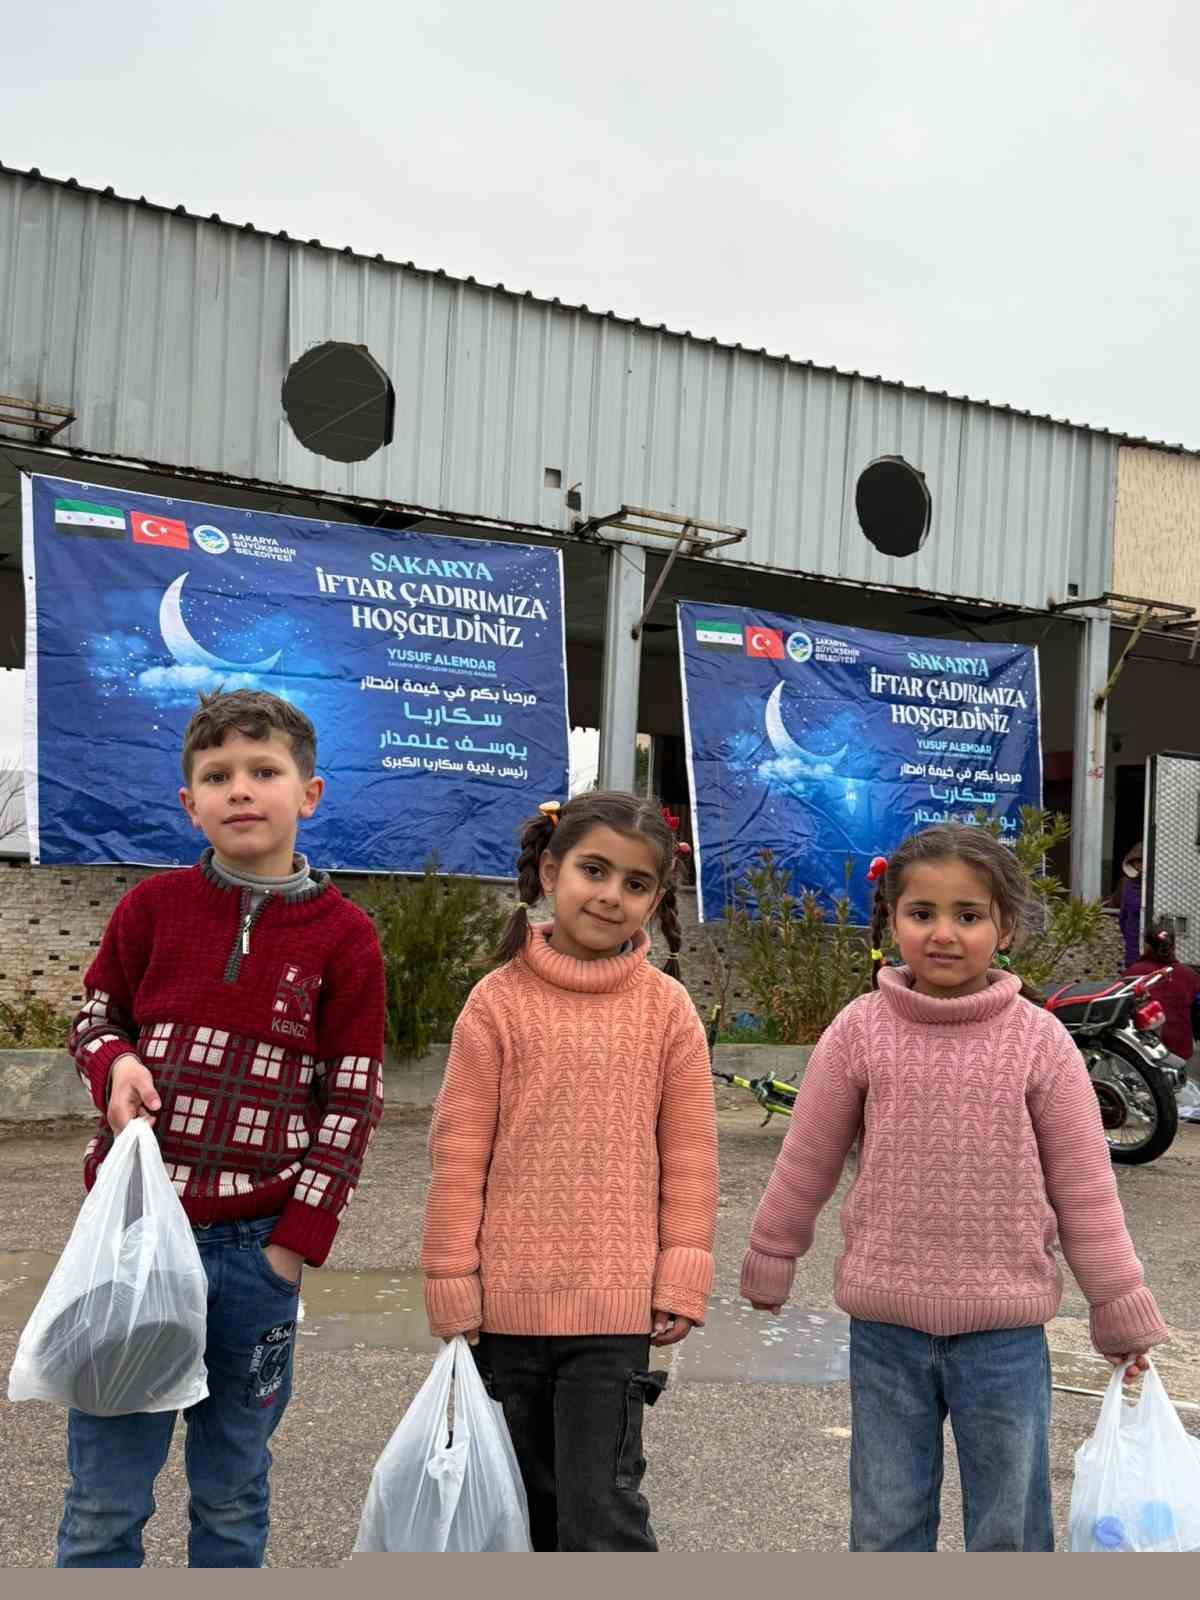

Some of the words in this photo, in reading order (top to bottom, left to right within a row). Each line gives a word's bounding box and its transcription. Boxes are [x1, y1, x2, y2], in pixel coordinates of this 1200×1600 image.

[231, 533, 279, 546] SAKARYA
[370, 551, 494, 583] SAKARYA
[315, 566, 397, 601] İFTAR
[399, 582, 549, 621] ÇADIRIMIZA
[351, 605, 524, 649] HOŞGELDİNİZ
[387, 648, 433, 664] YUSUF
[434, 653, 497, 672] ALEMDAR
[907, 651, 990, 678] SAKARYA
[402, 679, 440, 696] خيمة
[443, 685, 466, 702] في
[470, 687, 499, 704] بكم
[870, 666, 923, 698] İFTAR
[926, 679, 1028, 710] ÇADIRIMIZA
[403, 701, 502, 726] سكاريا
[891, 703, 1010, 734] HOŞGELDİNİZ
[379, 729, 450, 749] علمدار
[917, 738, 948, 751] YUSUF
[949, 742, 992, 755] ALEMDAR
[455, 736, 528, 761] يوسف
[423, 757, 464, 771] سكاريا
[466, 760, 496, 775] بلدية
[498, 765, 528, 779] رئيس
[928, 764, 955, 780] خيمة
[956, 767, 972, 782] في
[974, 769, 993, 783] بكم
[929, 784, 996, 804] سكاريا
